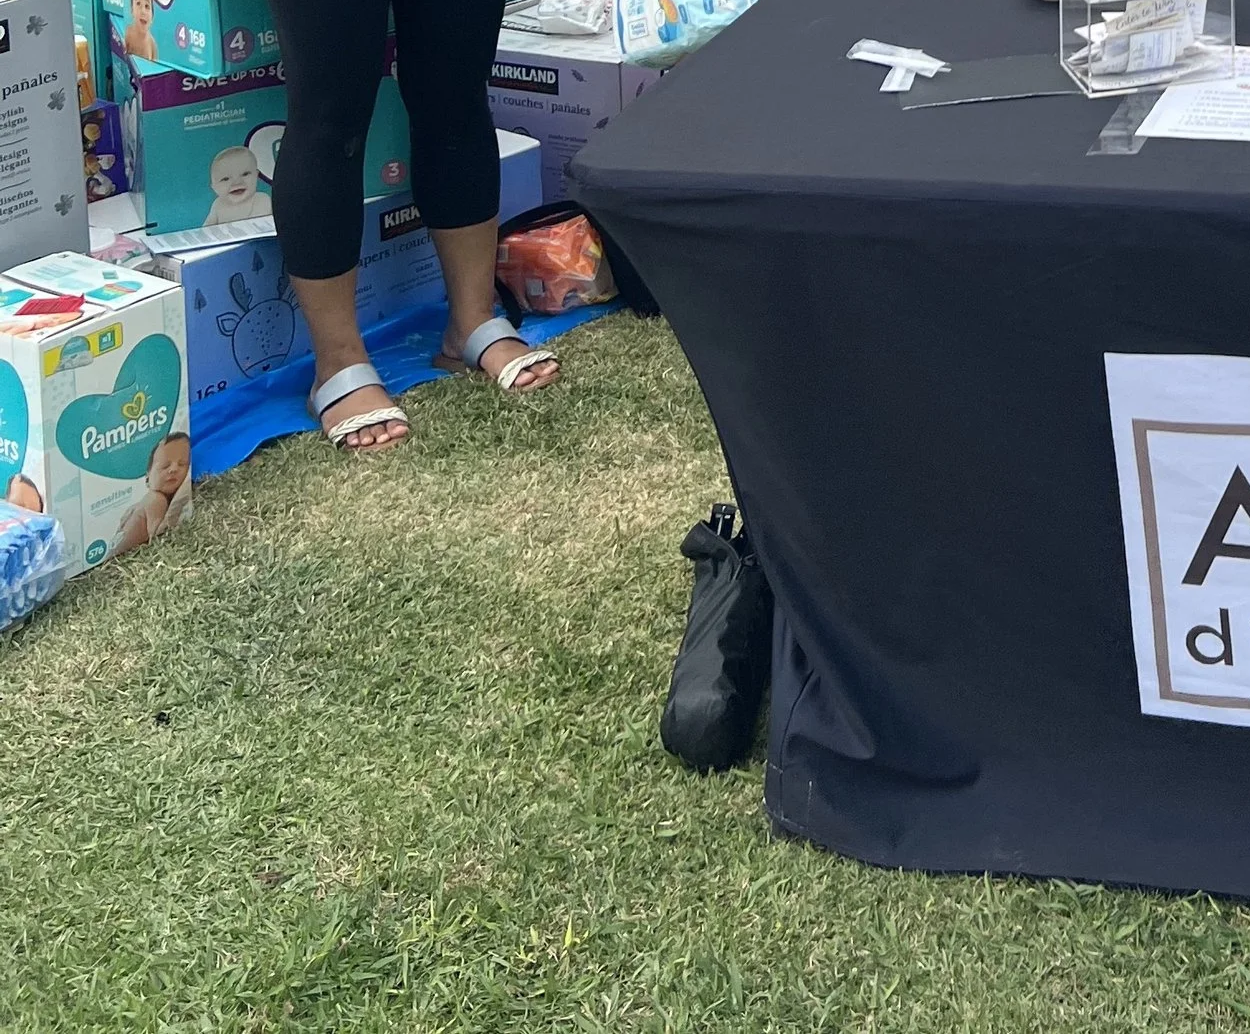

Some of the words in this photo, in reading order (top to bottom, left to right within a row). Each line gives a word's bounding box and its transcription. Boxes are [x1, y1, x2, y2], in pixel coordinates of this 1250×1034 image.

[178, 26, 186, 40] 4
[189, 28, 206, 48] 168
[230, 30, 246, 50] 4
[257, 29, 279, 46] 16
[182, 75, 229, 91] SAVE
[231, 71, 247, 82] UP
[250, 68, 266, 78] TO
[491, 63, 557, 84] KIRKLAND
[2, 71, 58, 101] pañales
[183, 107, 246, 125] PEDIATRICIAN
[503, 96, 544, 110] couches
[551, 97, 592, 117] pañales
[386, 161, 400, 178] 3
[383, 204, 421, 229] KIRK
[81, 406, 168, 460] Pampers
[90, 486, 133, 510] sensitive
[87, 545, 105, 560] 576
